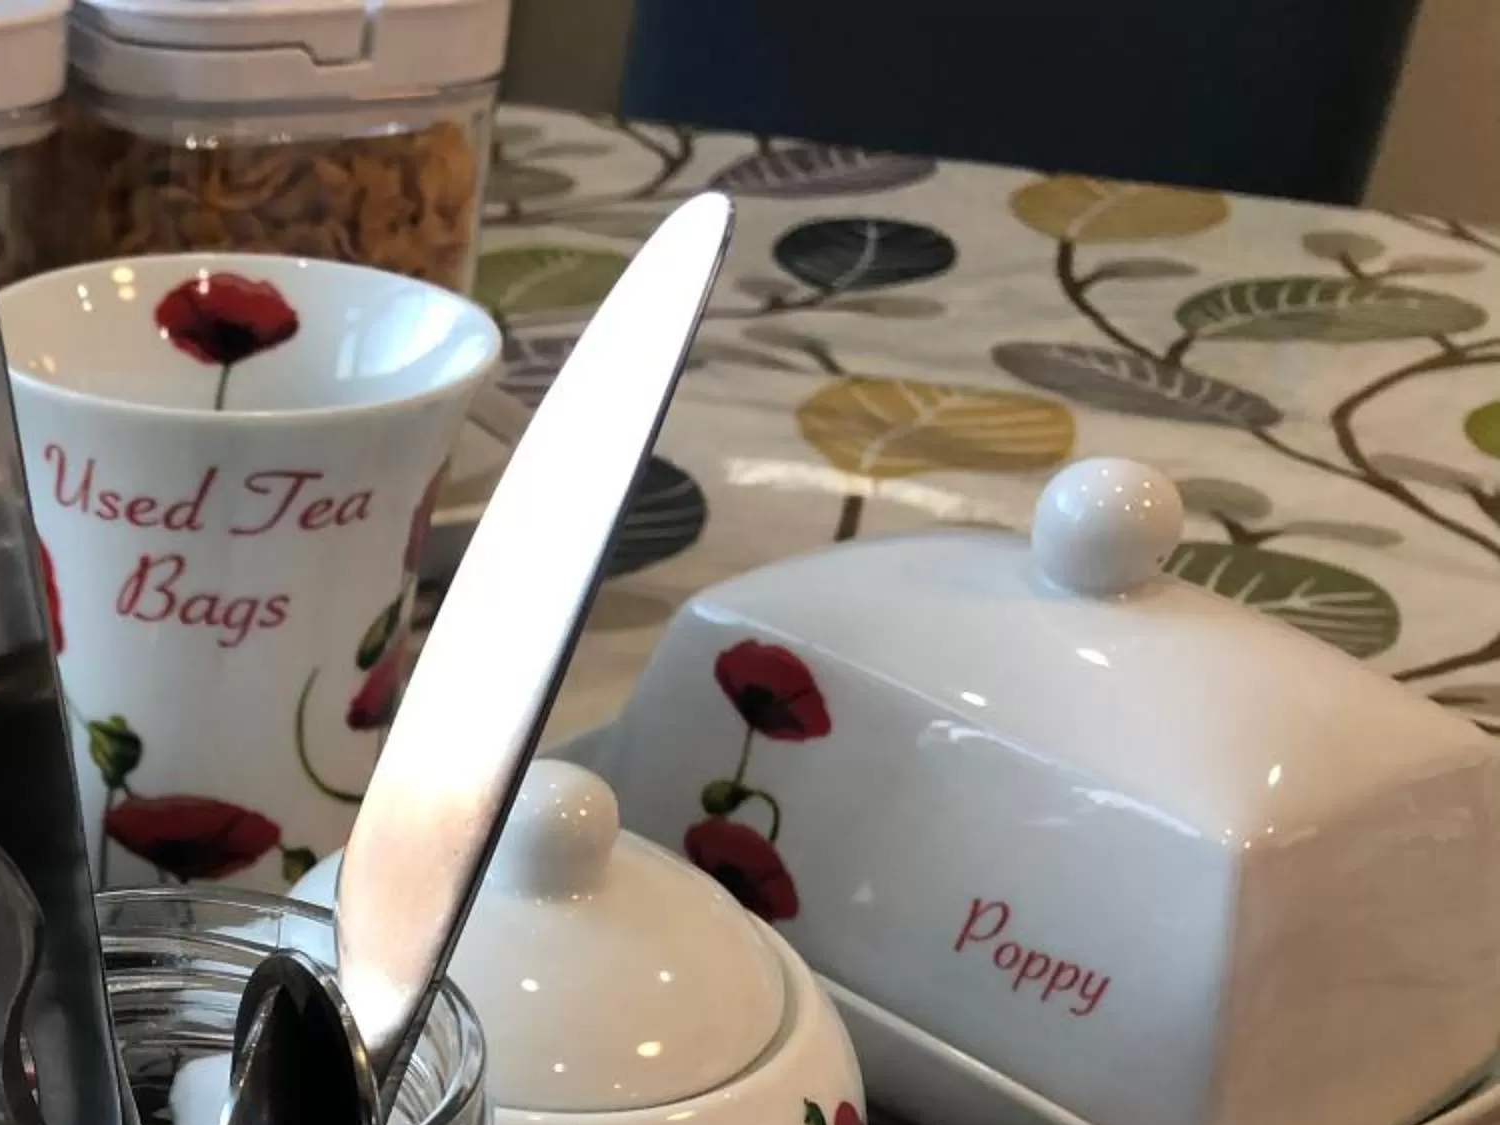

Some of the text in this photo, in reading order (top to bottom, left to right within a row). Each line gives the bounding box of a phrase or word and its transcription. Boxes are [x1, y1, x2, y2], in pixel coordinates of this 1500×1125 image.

[43, 443, 376, 536] Used Tea
[114, 552, 294, 649] Bags
[952, 897, 1112, 1017] Poppy
